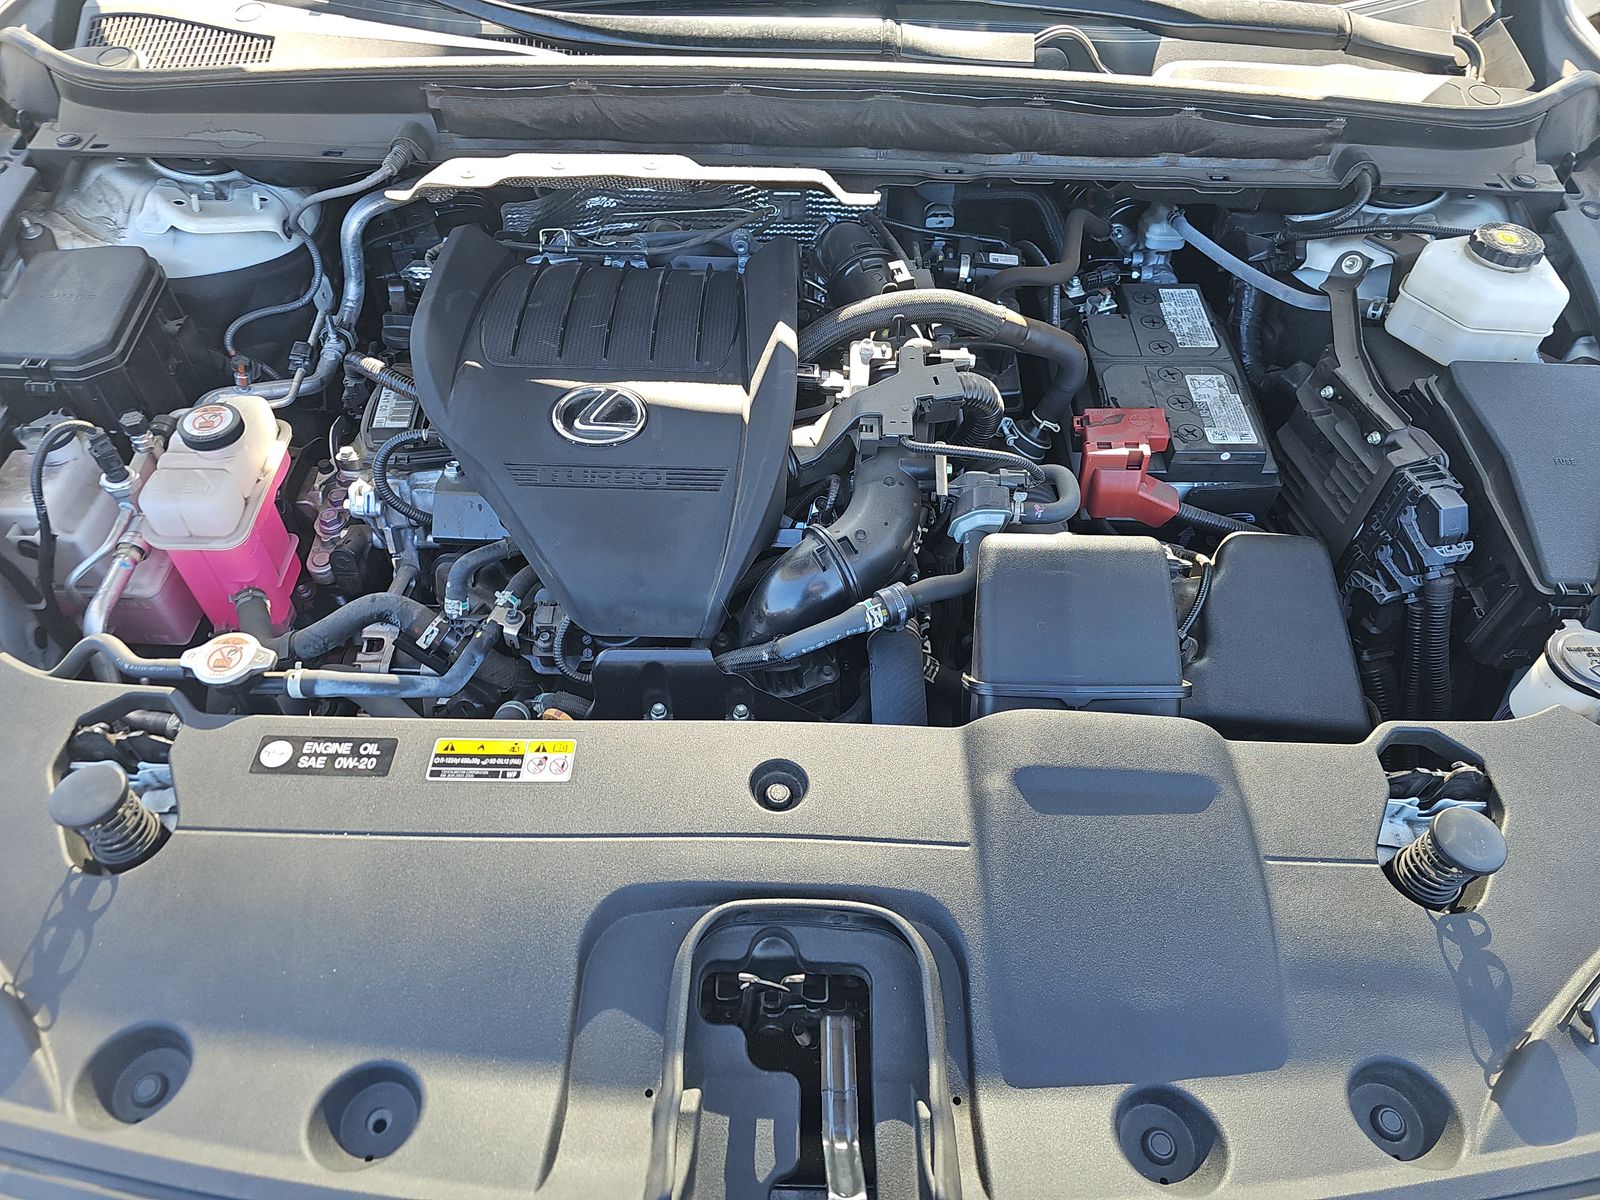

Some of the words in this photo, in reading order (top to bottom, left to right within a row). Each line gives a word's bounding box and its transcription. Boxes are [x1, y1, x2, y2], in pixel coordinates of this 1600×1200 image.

[542, 468, 663, 486] TURBO
[302, 742, 353, 755] ENGINE
[359, 742, 381, 756] OIL
[297, 756, 327, 769] SAE
[334, 757, 378, 770] 0W-20
